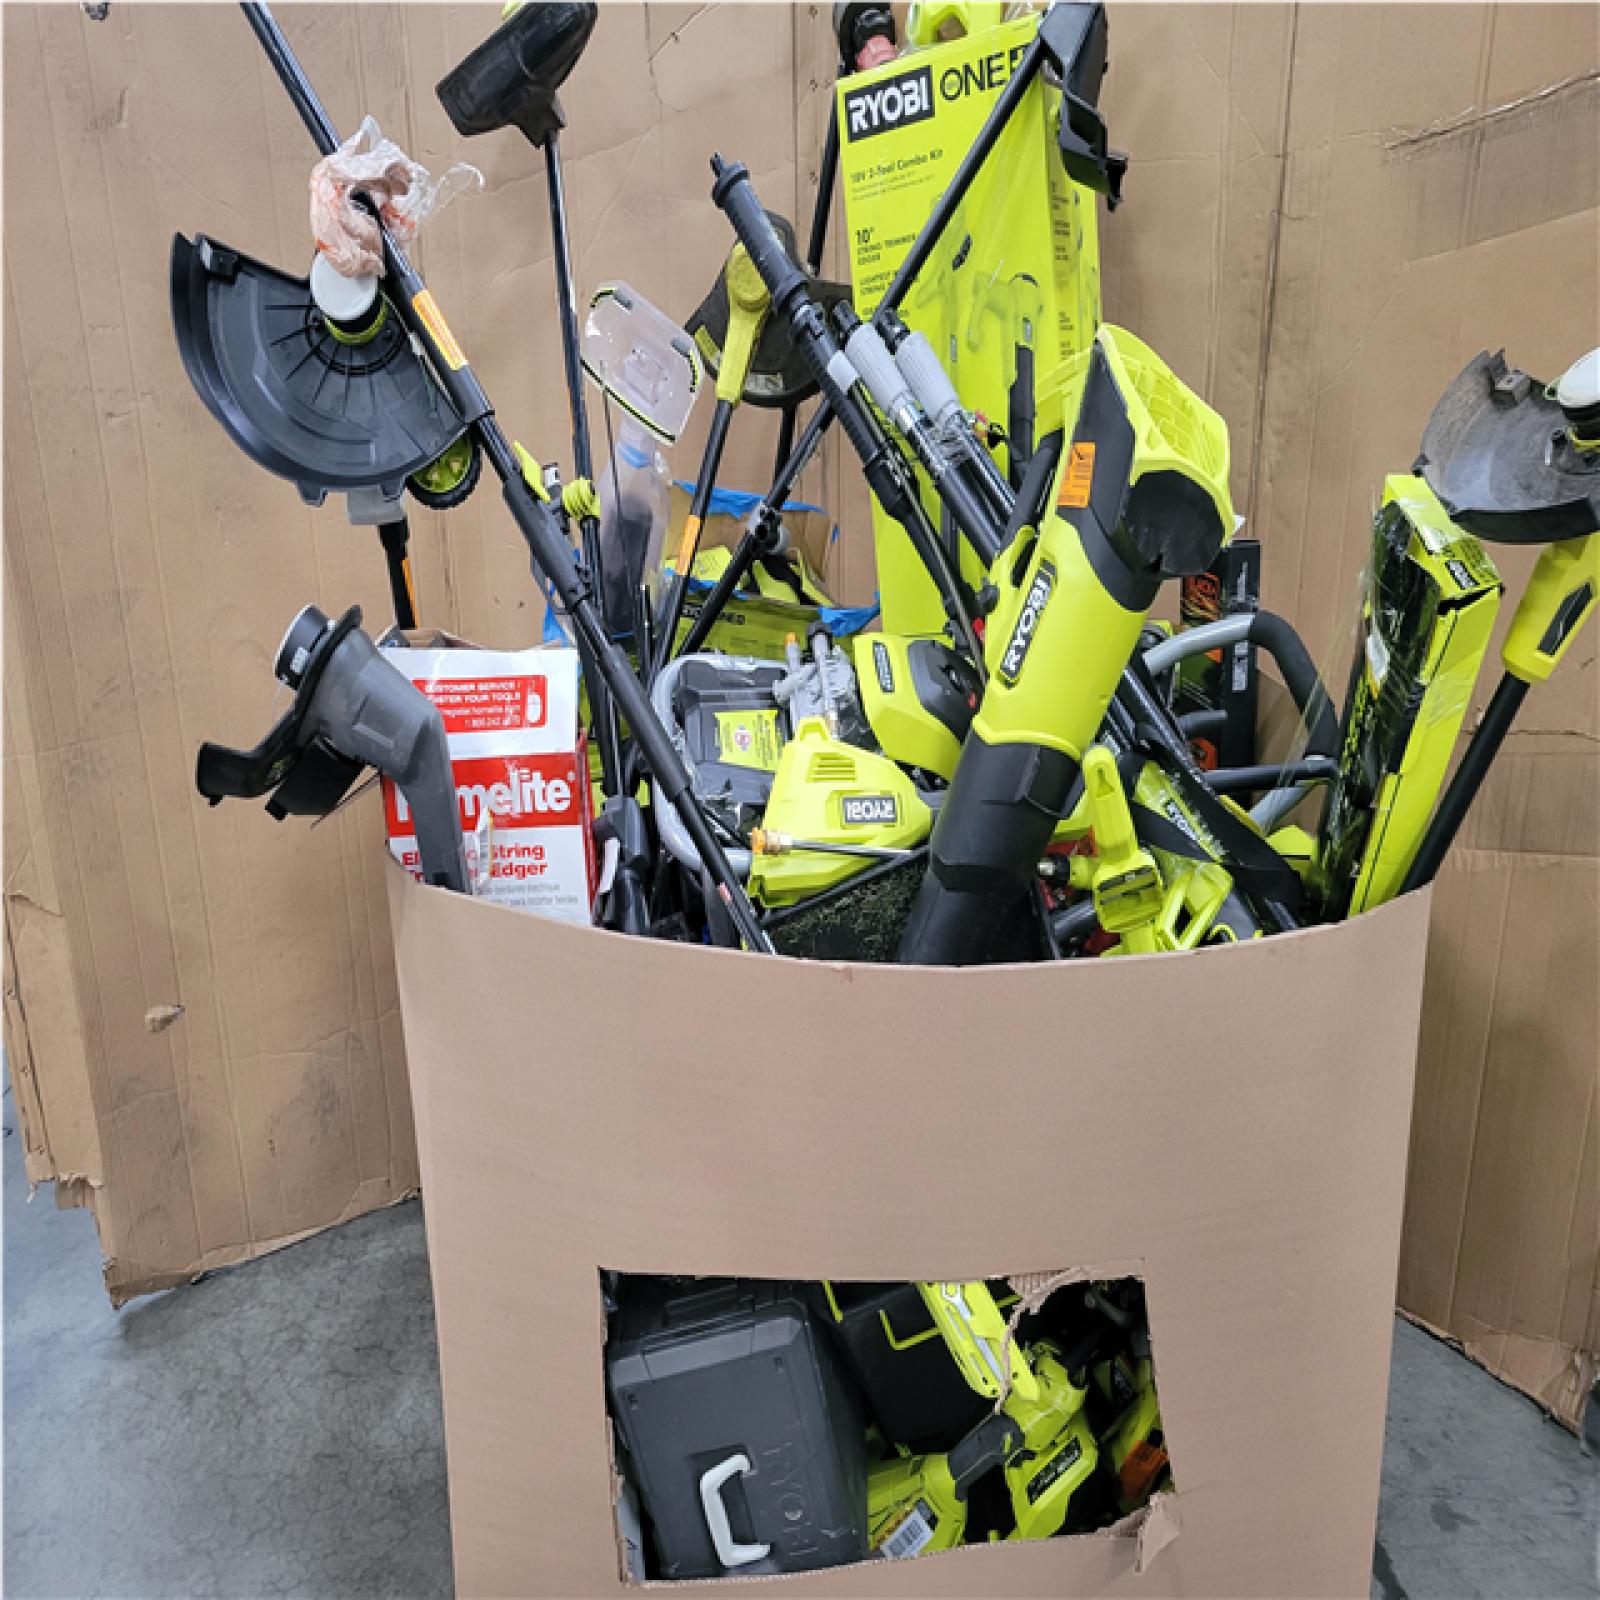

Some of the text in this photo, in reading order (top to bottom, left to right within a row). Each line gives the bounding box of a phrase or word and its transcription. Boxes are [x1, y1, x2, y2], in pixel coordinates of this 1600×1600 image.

[848, 77, 930, 133] RYOBI
[1003, 571, 1051, 675] RYOBI
[396, 769, 571, 822] melite
[846, 798, 895, 823] RYOBI
